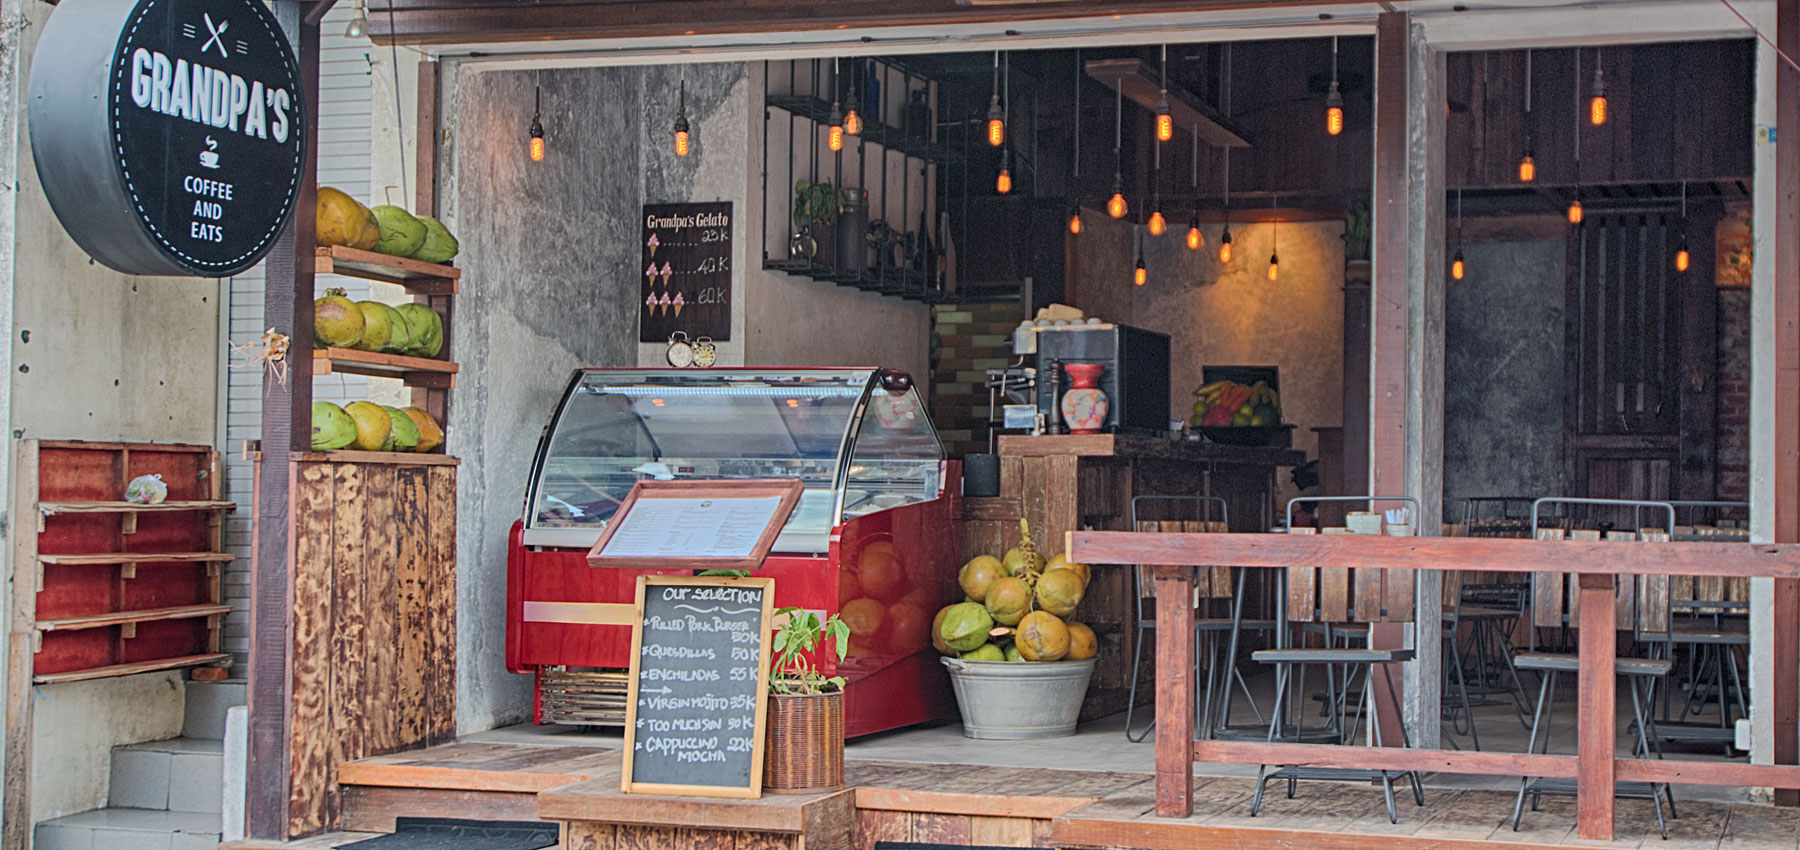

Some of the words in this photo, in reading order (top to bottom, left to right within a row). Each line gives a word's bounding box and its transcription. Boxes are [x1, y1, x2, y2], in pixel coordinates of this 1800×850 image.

[131, 47, 291, 143] GRANDPA'S
[184, 175, 233, 200] COFFEE
[193, 200, 223, 220] AND
[190, 221, 223, 243] EATS
[647, 213, 694, 232] Grandpa's
[696, 212, 728, 227] Gelato
[648, 668, 720, 682] ENCHILADAS
[677, 750, 726, 762] MOCHA
